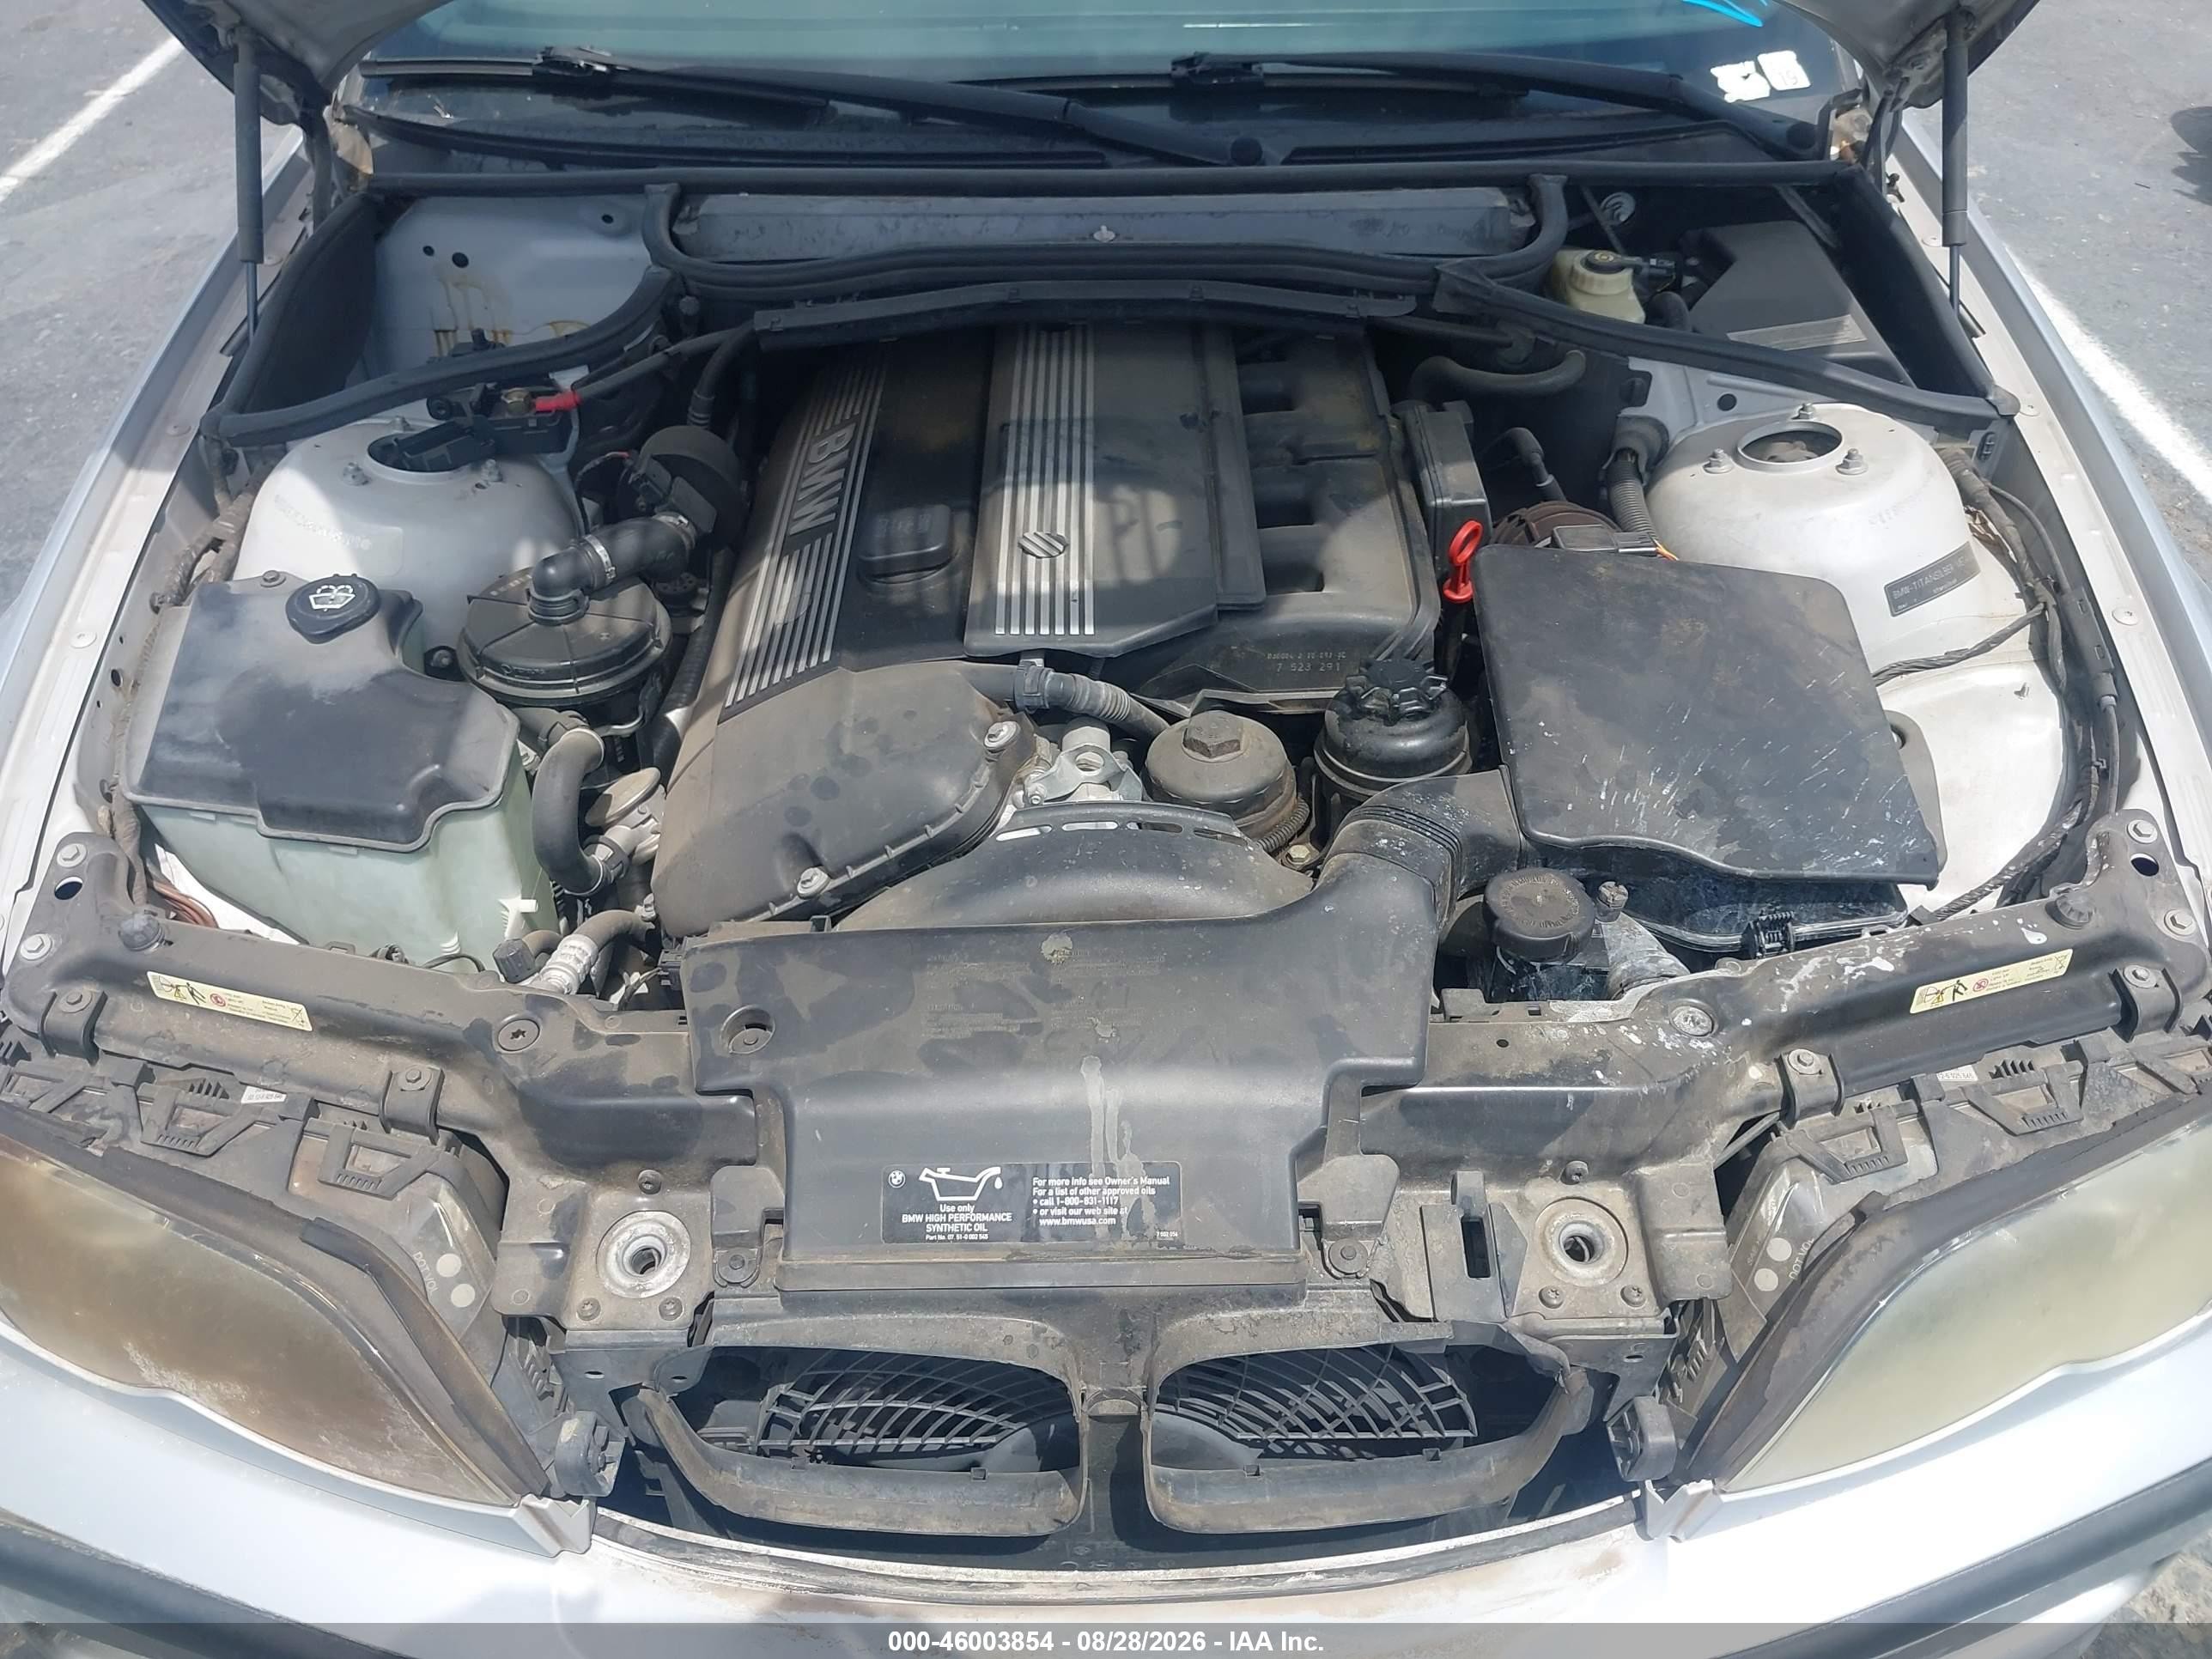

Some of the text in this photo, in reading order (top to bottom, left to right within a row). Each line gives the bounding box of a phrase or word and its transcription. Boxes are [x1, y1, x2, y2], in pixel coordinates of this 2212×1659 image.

[788, 422, 857, 536] BMW
[1291, 662, 1312, 672] 523
[1320, 662, 1340, 672] 291
[1032, 1177, 1048, 1186] For
[1071, 1176, 1087, 1185] info
[1104, 1176, 1139, 1185] Owner's
[1139, 1176, 1170, 1185] Manual
[1032, 1187, 1047, 1195] For
[1054, 1187, 1068, 1195] list
[1069, 1187, 1079, 1195] of
[1079, 1187, 1101, 1195] other
[1102, 1186, 1139, 1197] approved
[1140, 1186, 1156, 1194] oils
[1039, 1196, 1119, 1206] call 1-800-831-1117
[939, 1203, 975, 1214] Use only
[1049, 1206, 1067, 1216] visit
[1068, 1207, 1083, 1216] our
[1084, 1206, 1102, 1215] web
[902, 1212, 1012, 1223] BMW HIGH PERFORMANCE
[1039, 1217, 1116, 1225] www.bmwusa.com
[926, 1224, 972, 1232] SYNTHETIC
[1789, 1257, 1803, 1279] DOT
[412, 1251, 439, 1299] DOT VOL
